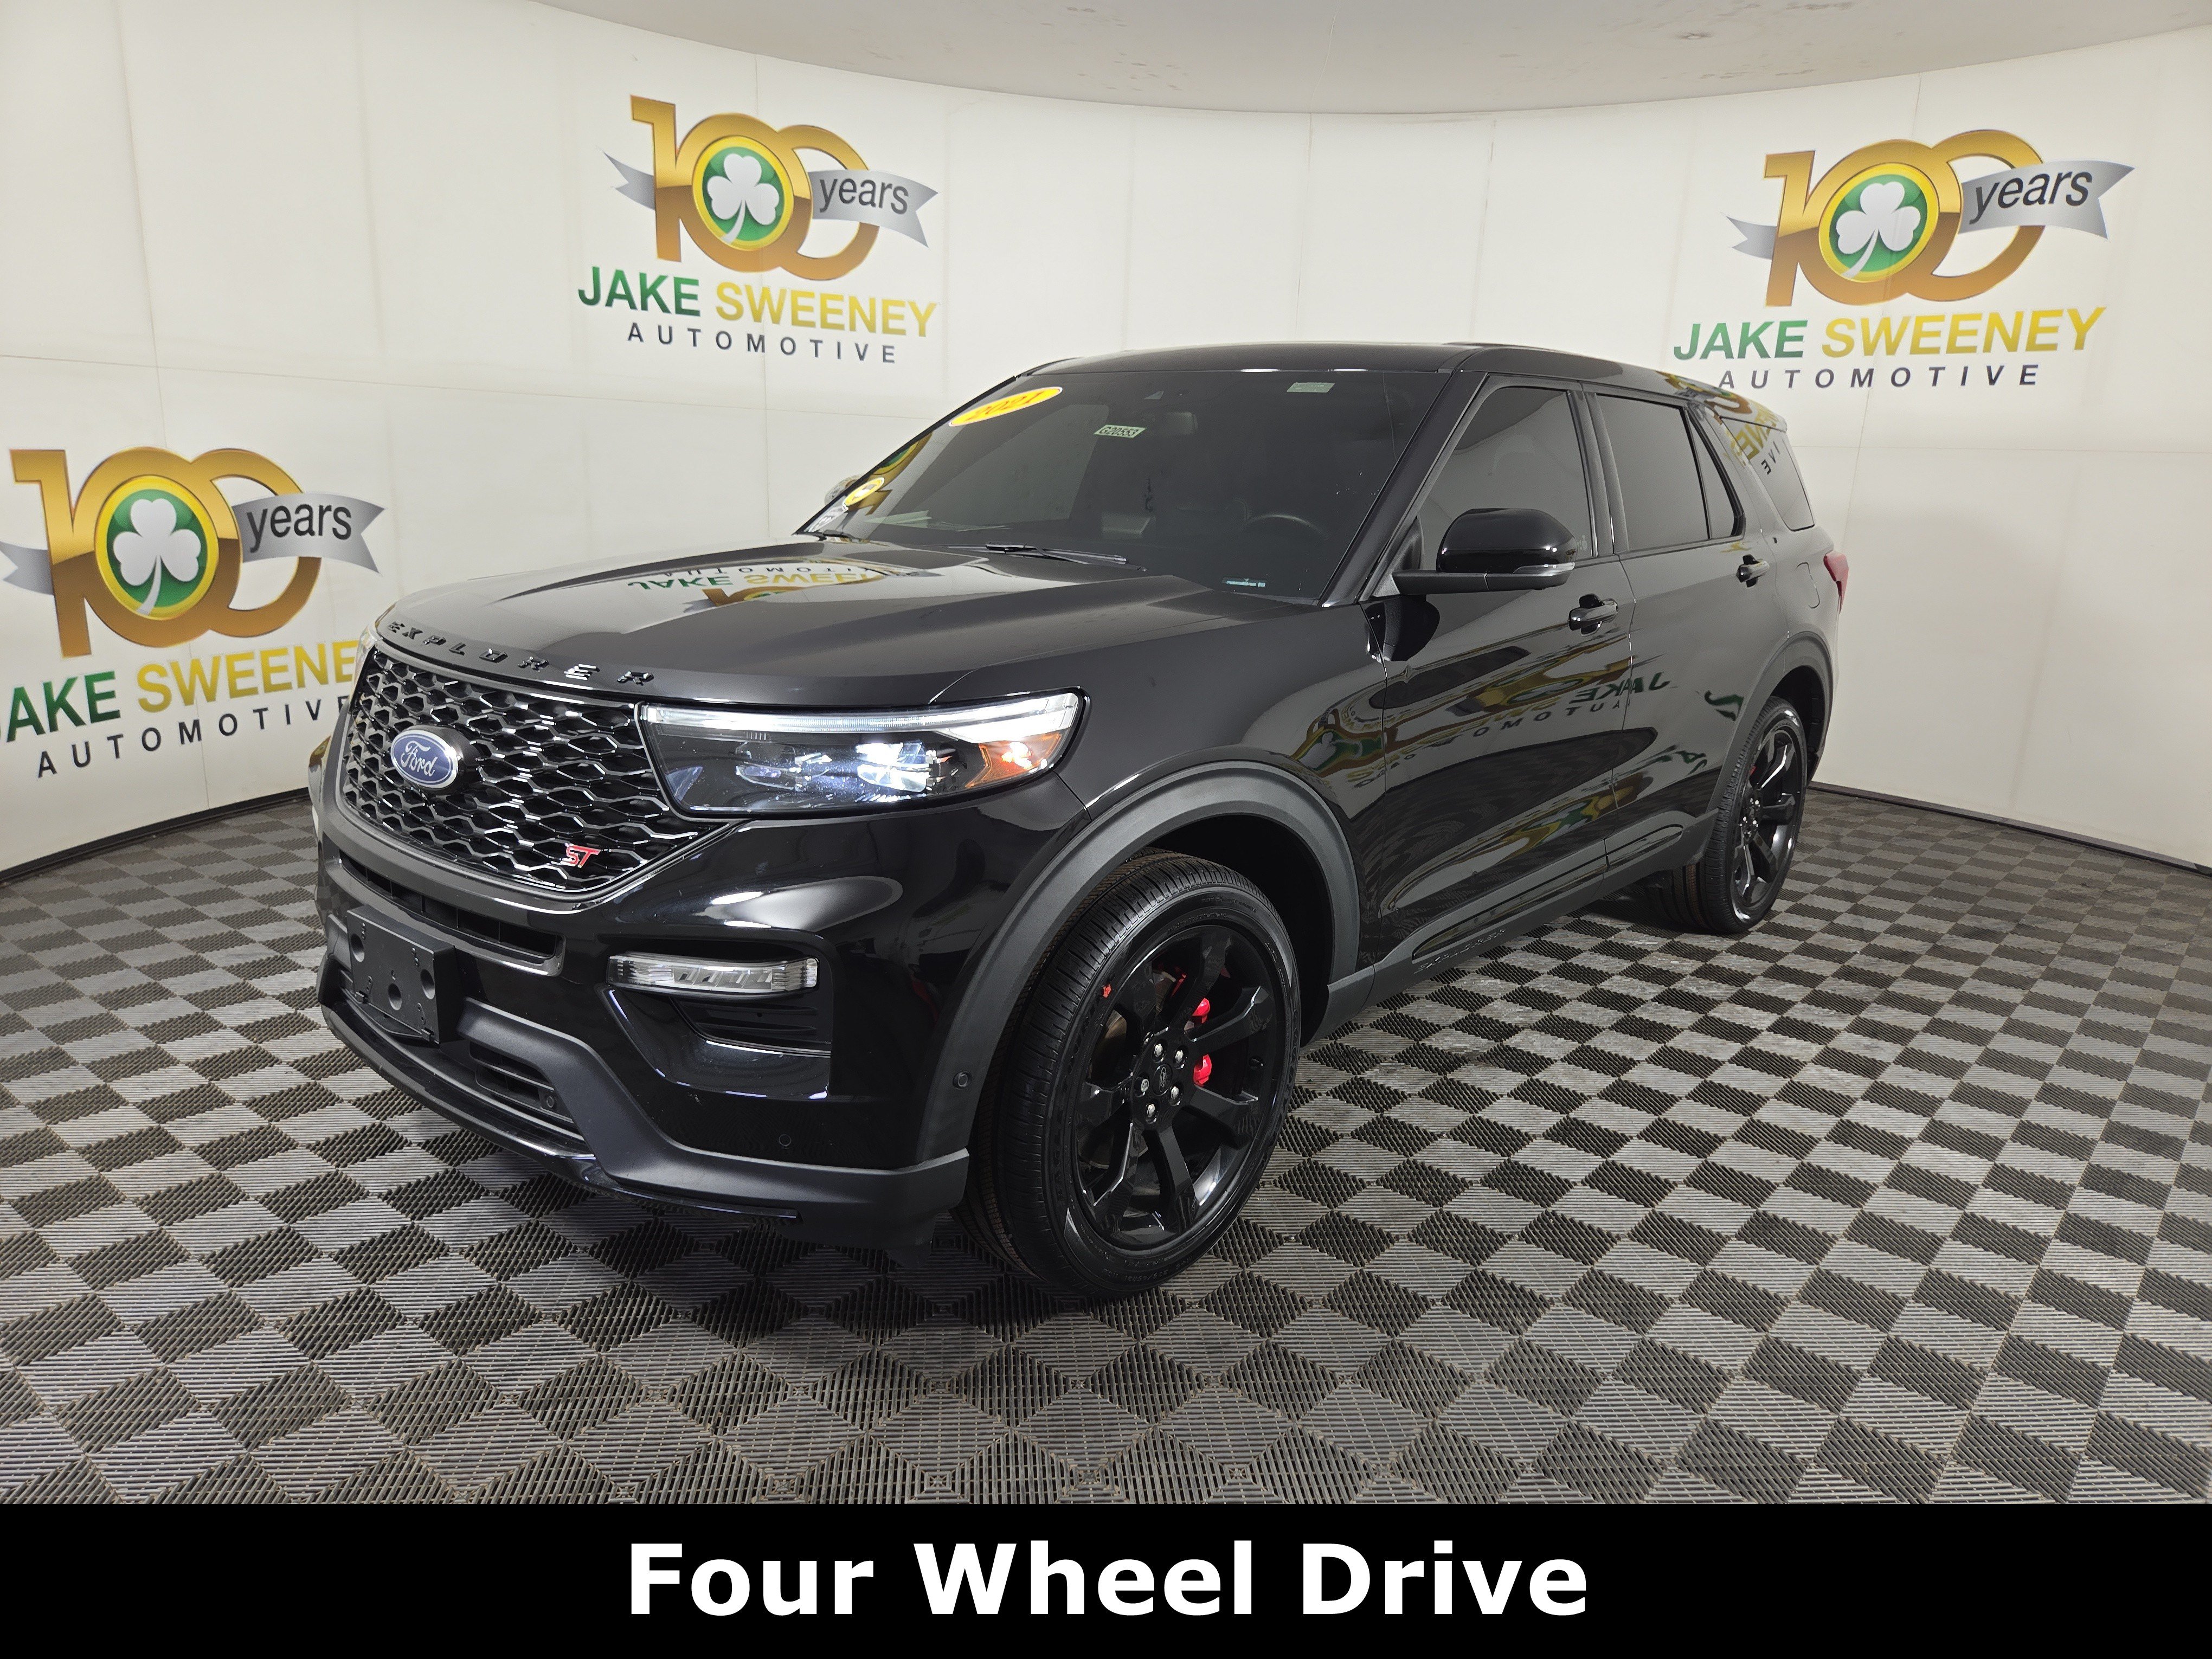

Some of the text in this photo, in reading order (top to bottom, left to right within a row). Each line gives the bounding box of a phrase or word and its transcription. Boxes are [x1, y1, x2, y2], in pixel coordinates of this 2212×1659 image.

[630, 94, 880, 281] 100
[819, 177, 909, 215] years
[1969, 167, 2092, 224] years
[1764, 129, 2044, 307] 100
[578, 266, 938, 337] JAKE SWEENEY
[627, 322, 895, 364] AUTOMOTIVE
[1673, 306, 2106, 360] JAKE SWEENEY
[1719, 364, 2039, 389] AUTOMOTIVE
[9, 446, 321, 658] 100
[247, 504, 351, 553] years
[387, 621, 654, 685] EXPLORER
[0, 640, 359, 742] AKE SWEENE
[402, 741, 436, 777] Ford
[565, 844, 600, 867] ST
